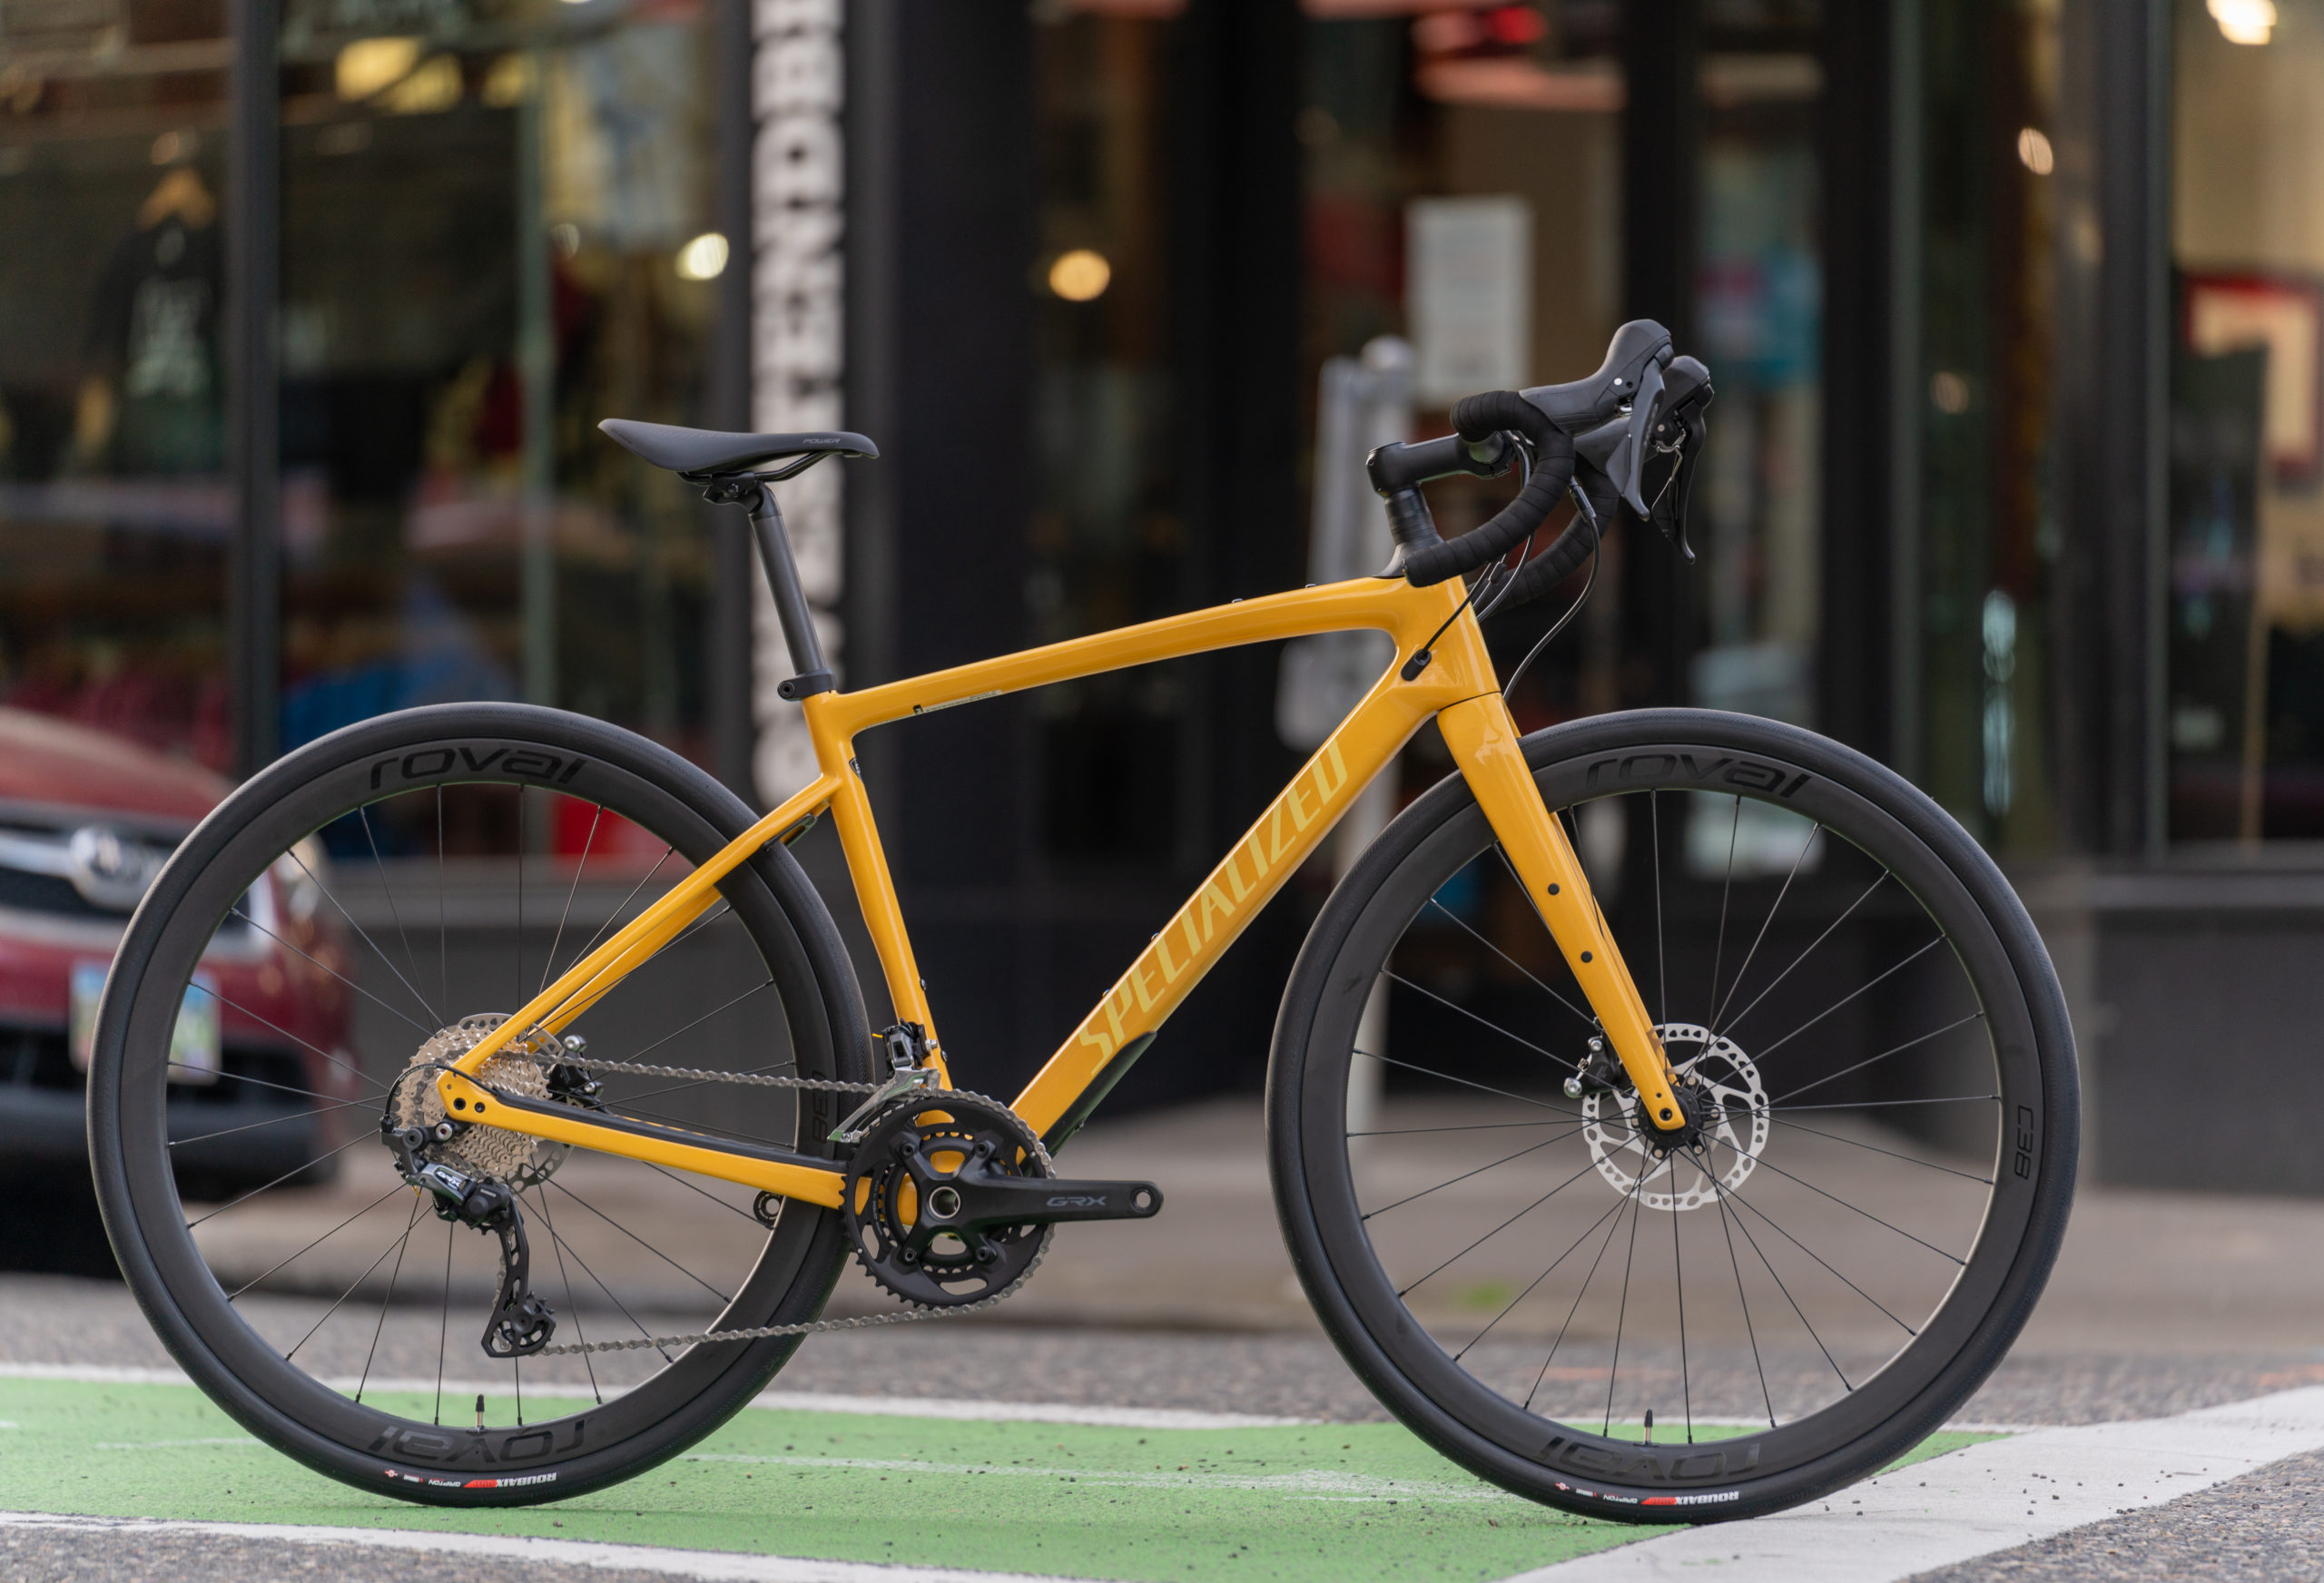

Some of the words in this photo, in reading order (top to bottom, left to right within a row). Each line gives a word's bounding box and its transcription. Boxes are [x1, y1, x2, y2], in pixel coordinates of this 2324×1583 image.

[369, 746, 588, 791] roval
[1586, 753, 1813, 800] roval
[1078, 738, 1349, 1077] SPECIALIZED
[2014, 1104, 2034, 1181] C38
[1046, 1195, 1108, 1206] GRX
[367, 1418, 586, 1464] roval
[1539, 1435, 1761, 1481] roval
[495, 1471, 557, 1488] ROUBAIX
[1674, 1490, 1740, 1506] ROUBAIX
